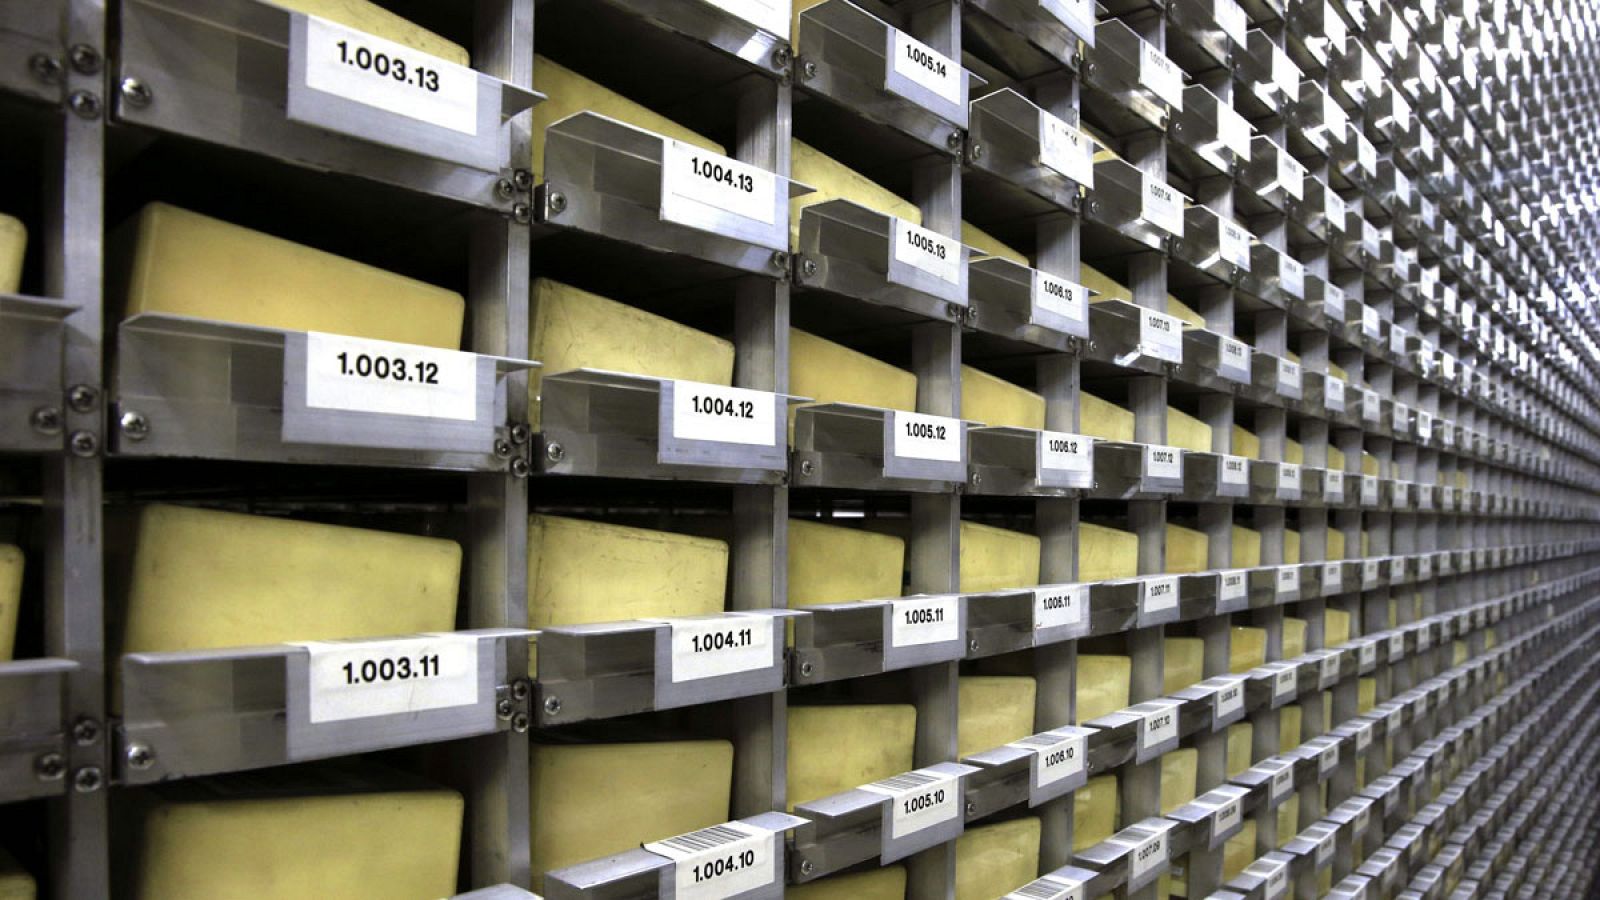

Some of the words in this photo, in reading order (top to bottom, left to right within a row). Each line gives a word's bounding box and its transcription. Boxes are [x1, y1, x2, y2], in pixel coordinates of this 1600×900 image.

[337, 41, 439, 92] 1.003.13
[906, 44, 946, 78] 1.005.14
[692, 157, 753, 192] 1.004.13
[907, 231, 945, 260] 1.005.13
[1044, 280, 1072, 301] 1.006.13
[1149, 316, 1170, 332] 1.007.13
[338, 352, 438, 384] 1.003.12
[692, 396, 753, 418] 1.004.12
[906, 422, 945, 440] 1.005.12
[1049, 440, 1077, 454] 1.006.12
[1153, 452, 1173, 463] 1.007.12
[1151, 584, 1170, 596] 1.007.11
[1044, 596, 1070, 609] 1.006.11
[905, 608, 943, 624] 1.005.11
[692, 629, 751, 652] 1.004.11
[343, 655, 438, 684] 1.003.11
[1150, 715, 1170, 731] 1.007.10
[1045, 747, 1073, 767] 1.006.10
[904, 789, 944, 813] 1.005.10
[693, 850, 754, 882] 1.004.10
